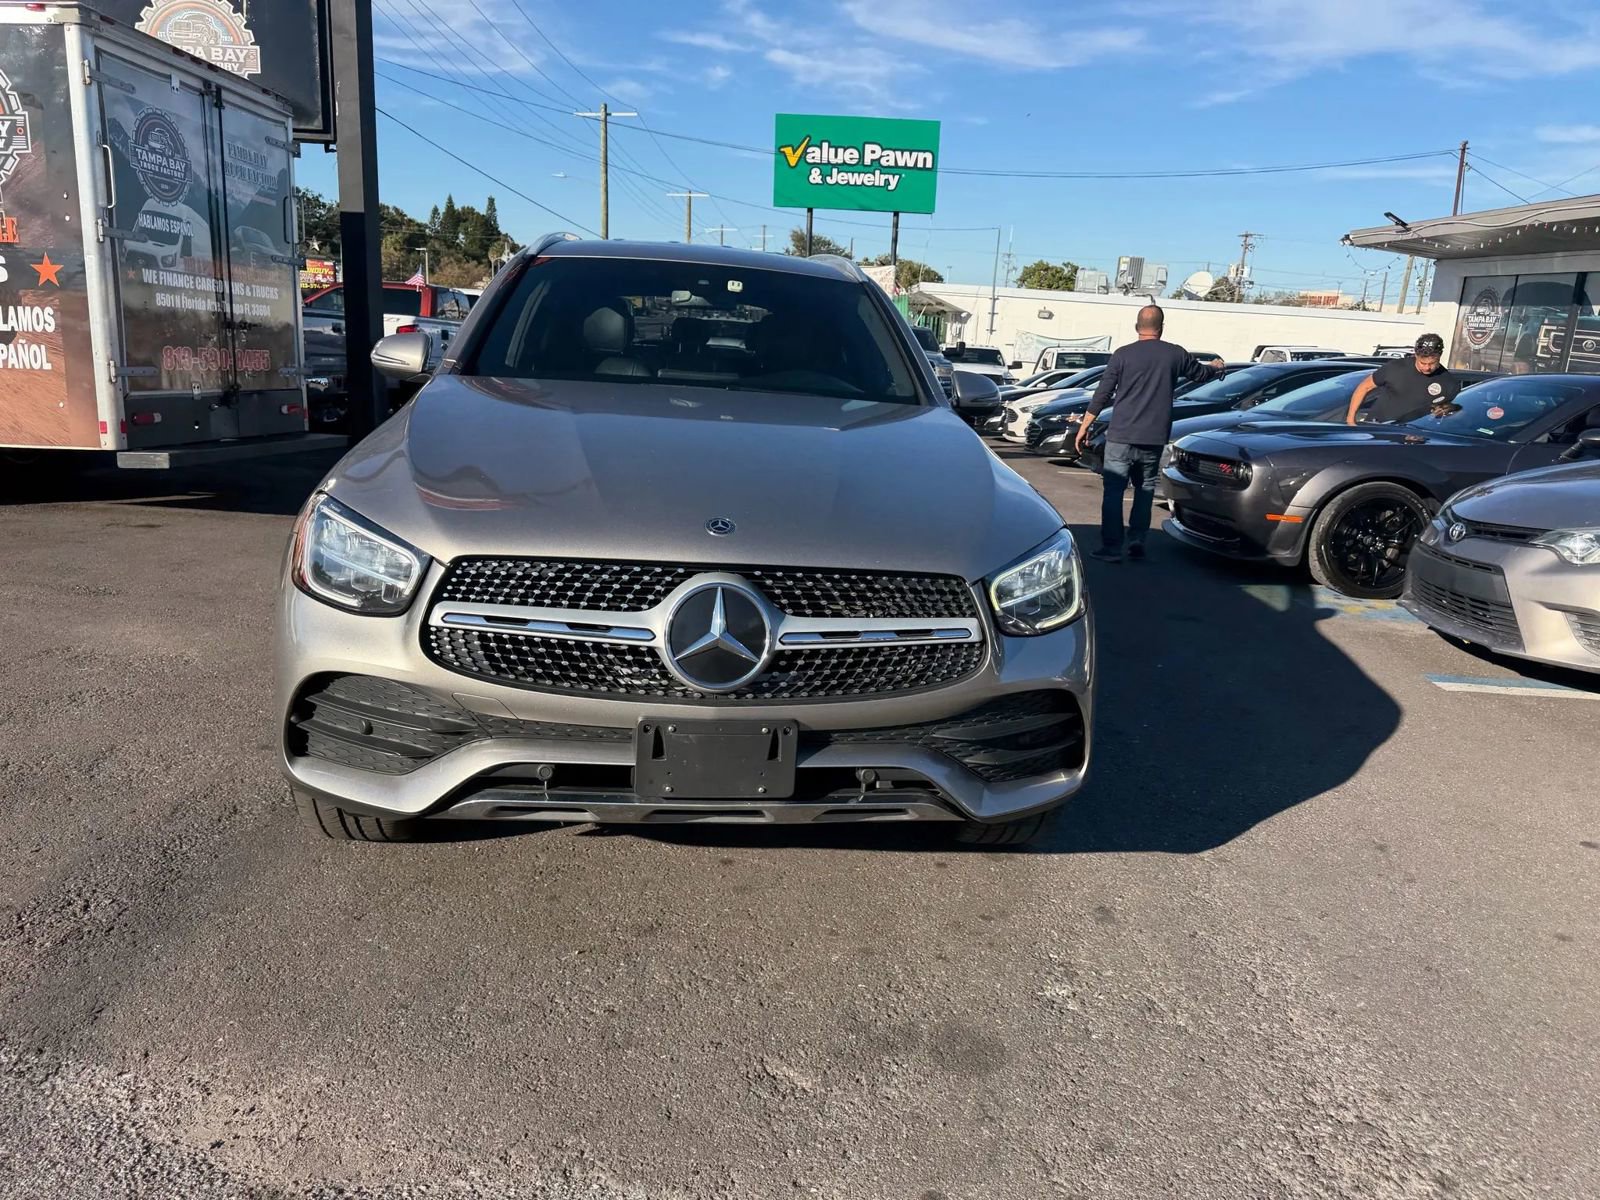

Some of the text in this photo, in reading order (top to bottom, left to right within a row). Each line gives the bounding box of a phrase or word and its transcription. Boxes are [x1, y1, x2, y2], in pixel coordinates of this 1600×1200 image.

[210, 47, 249, 63] BAY
[135, 148, 186, 173] TAMPA BAY
[780, 135, 934, 169] Value Pawn
[140, 160, 185, 179] TRUCK FACTORY
[808, 168, 899, 191] & Jewelry
[138, 212, 170, 232] HABLAMOS
[142, 268, 158, 285] WE
[159, 272, 194, 289] FINANCE
[252, 284, 279, 300] TRUCKS
[182, 294, 206, 311] Florida
